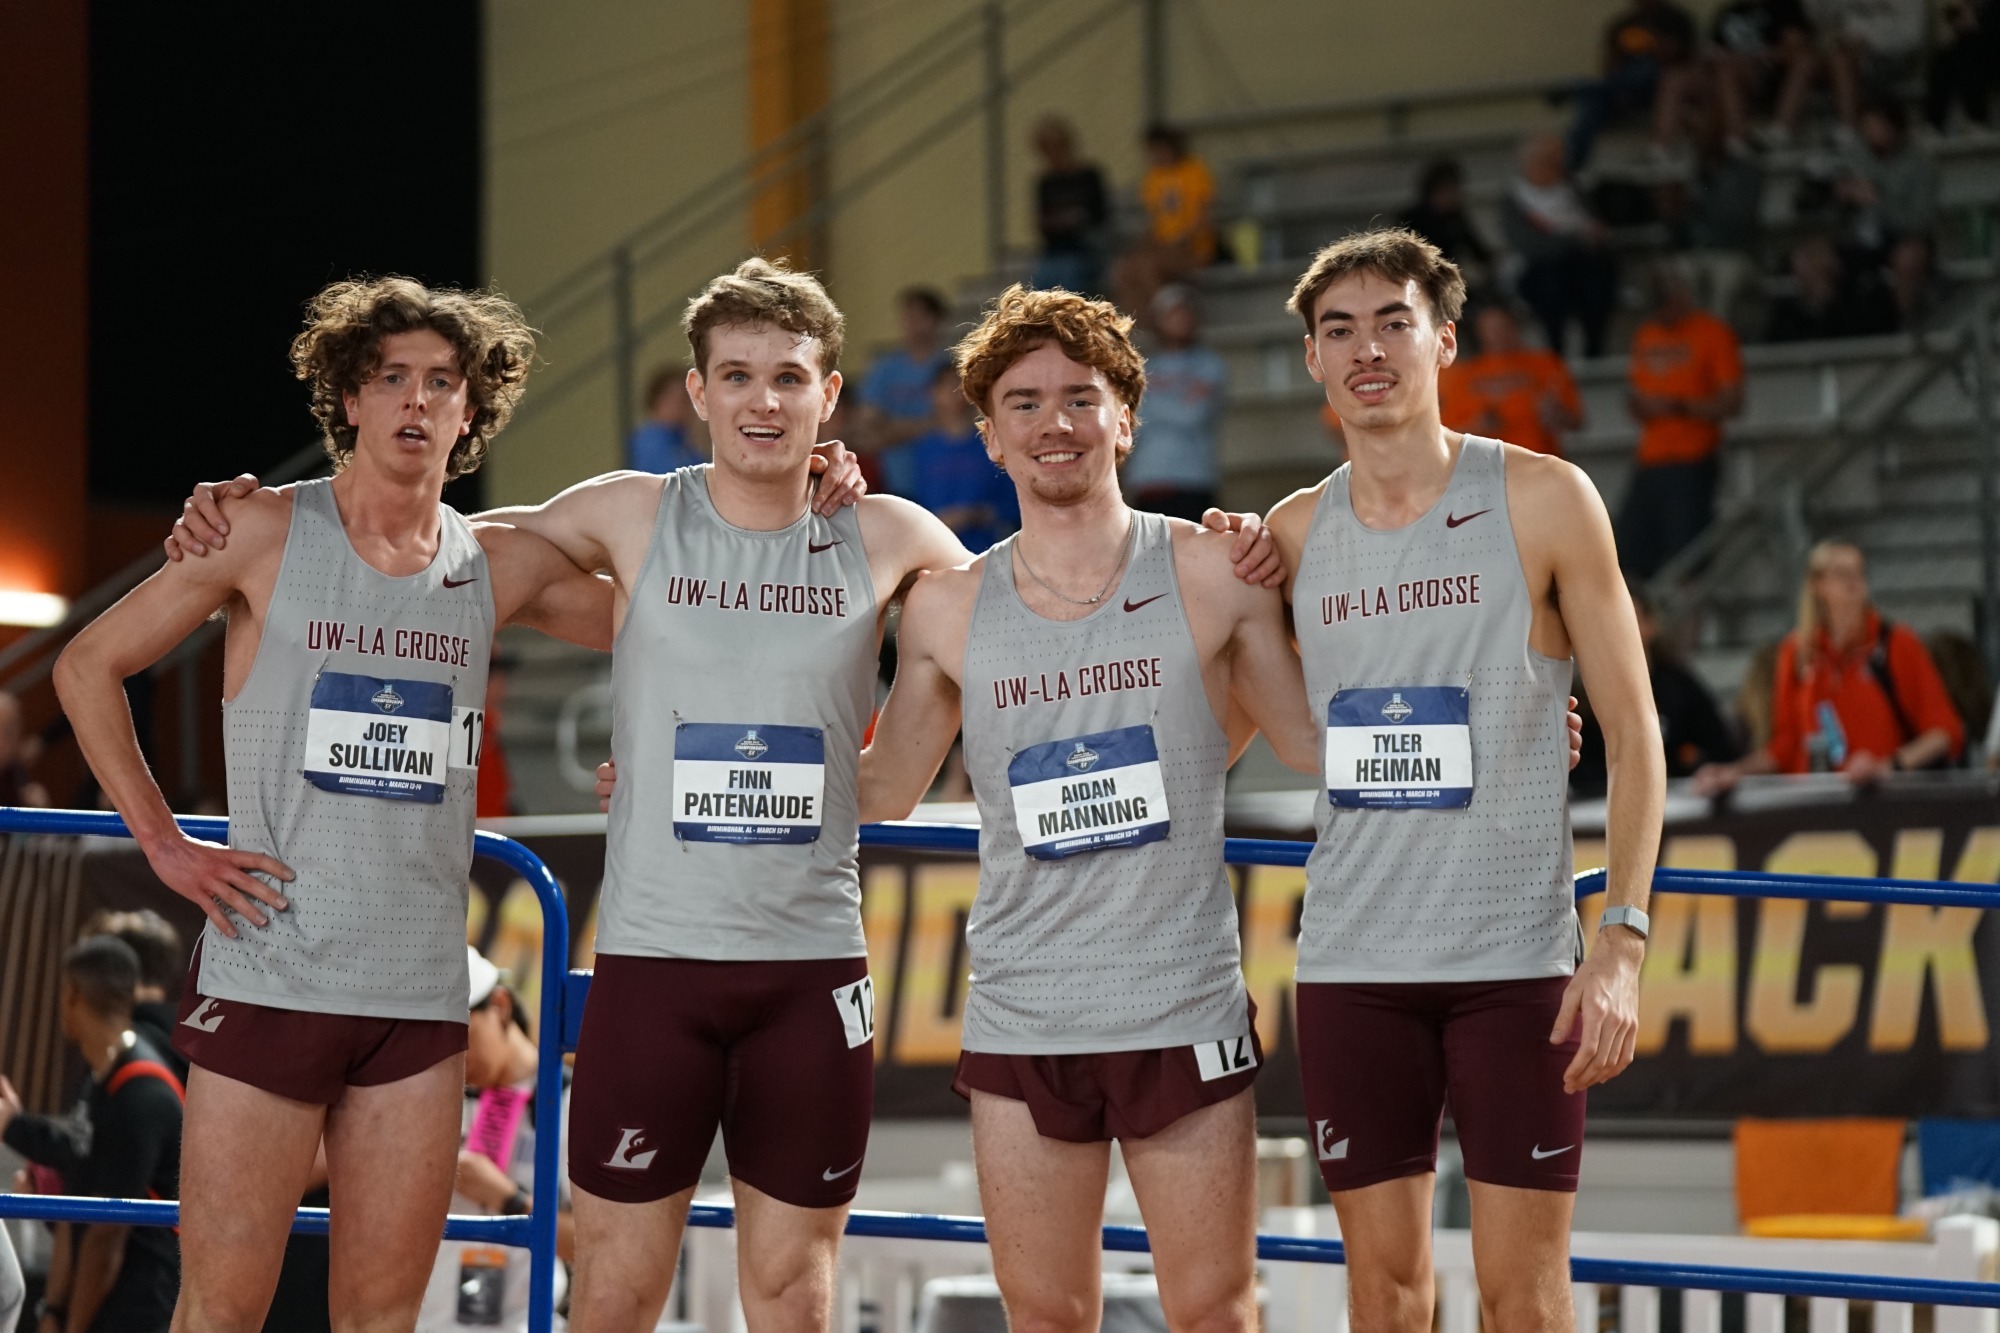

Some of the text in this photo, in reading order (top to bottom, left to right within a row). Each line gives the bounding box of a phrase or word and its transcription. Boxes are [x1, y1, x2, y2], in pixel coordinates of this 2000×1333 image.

[667, 575, 846, 618] UW-LA CROSSE
[1321, 573, 1481, 625] UW-LA CROSSE
[307, 620, 470, 668] UW-LA CROSSE
[993, 657, 1162, 710] UW-LA CROSSE
[363, 721, 408, 743] JOEY
[1373, 734, 1422, 753] TYLER
[328, 742, 433, 775] SULLIVAN
[1356, 757, 1441, 783] HEIMAN
[388, 781, 409, 789] MARCH
[728, 769, 772, 789] FINN
[1061, 777, 1117, 804] AIDAN
[684, 792, 814, 819] PATENAUDE
[1406, 790, 1425, 798] MARCH
[1038, 796, 1148, 837] MANNING
[1104, 832, 1125, 841] MARCH
